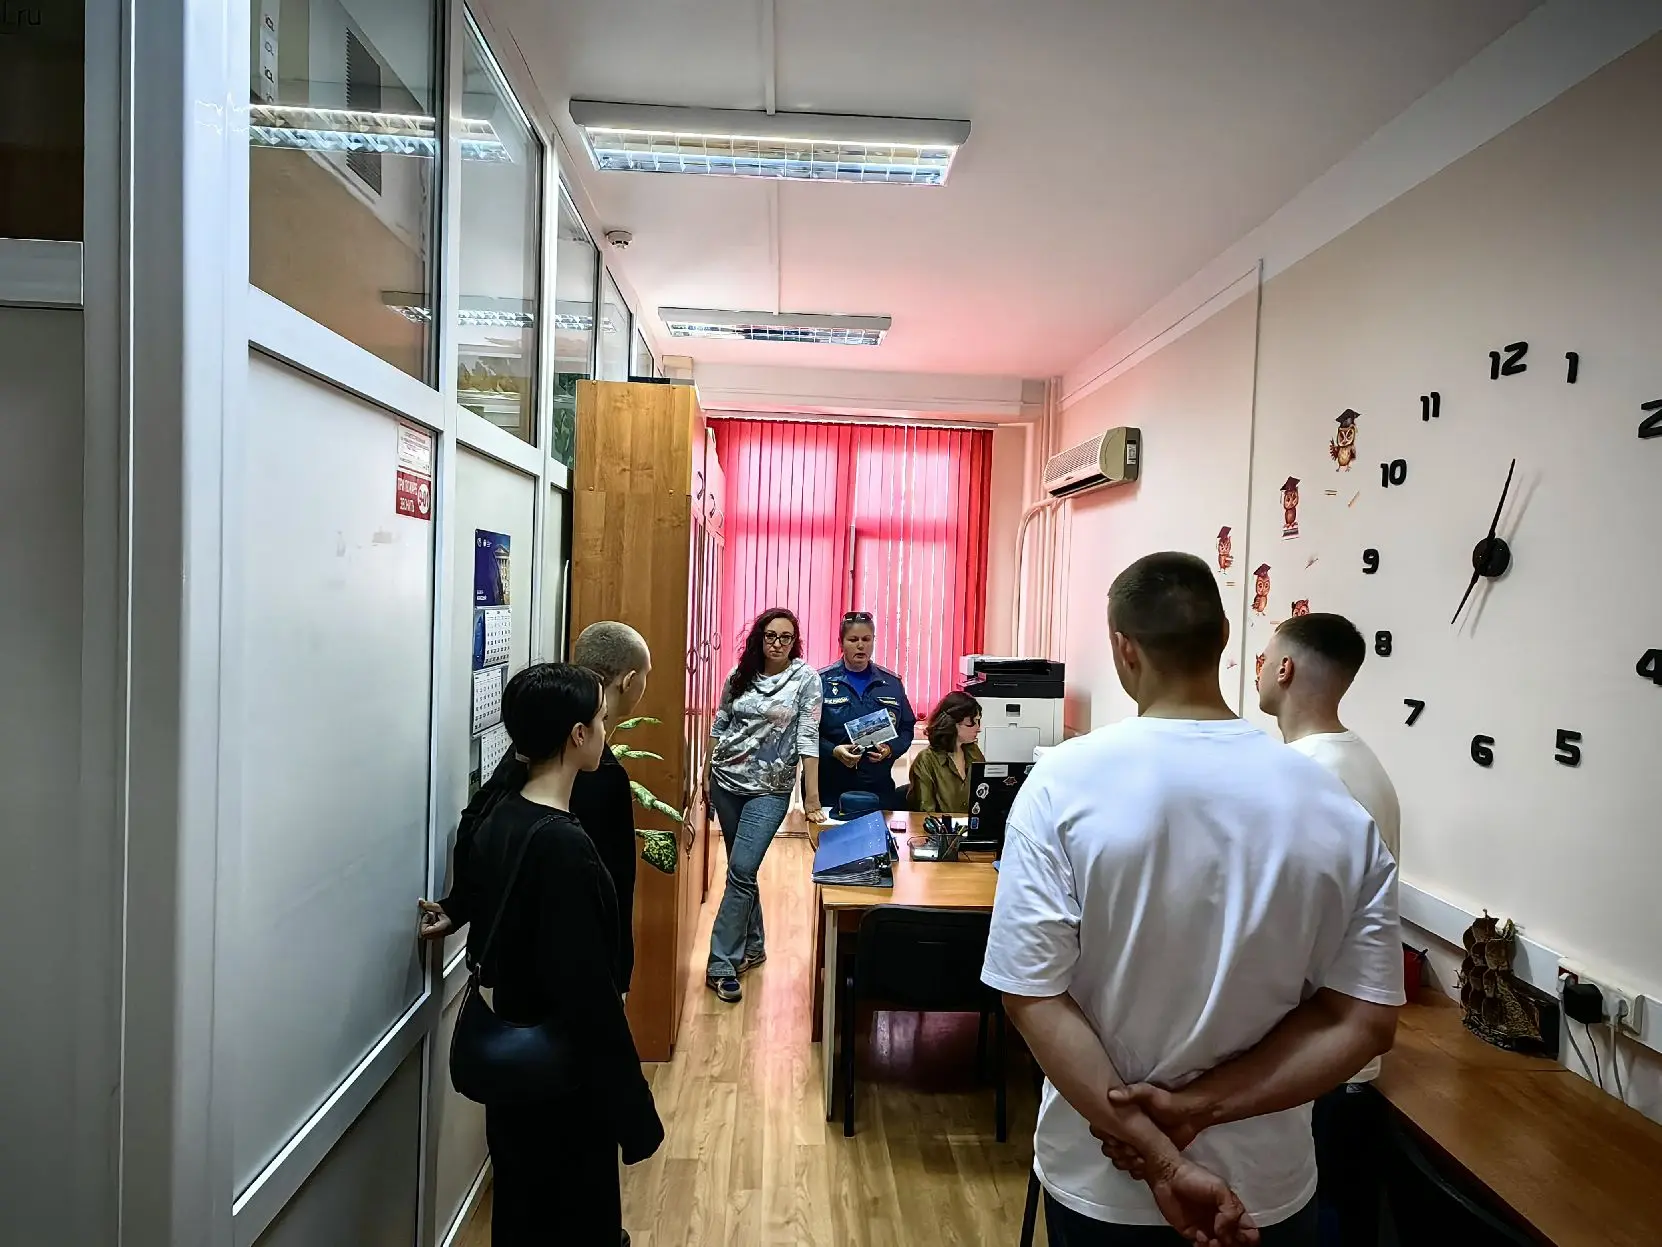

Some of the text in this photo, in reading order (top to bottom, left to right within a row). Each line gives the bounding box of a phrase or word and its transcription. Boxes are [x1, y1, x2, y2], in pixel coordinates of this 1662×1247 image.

[1489, 342, 1528, 380] 12
[1565, 352, 1579, 384] 1
[1420, 391, 1441, 421] 11
[1638, 399, 1662, 439] 2
[1380, 458, 1408, 488] 10
[1362, 548, 1380, 575] 9
[1375, 630, 1393, 657] 8
[1636, 649, 1662, 687] 4
[1403, 698, 1426, 727] 7
[1470, 734, 1495, 767] 6
[1554, 728, 1582, 767] 5
